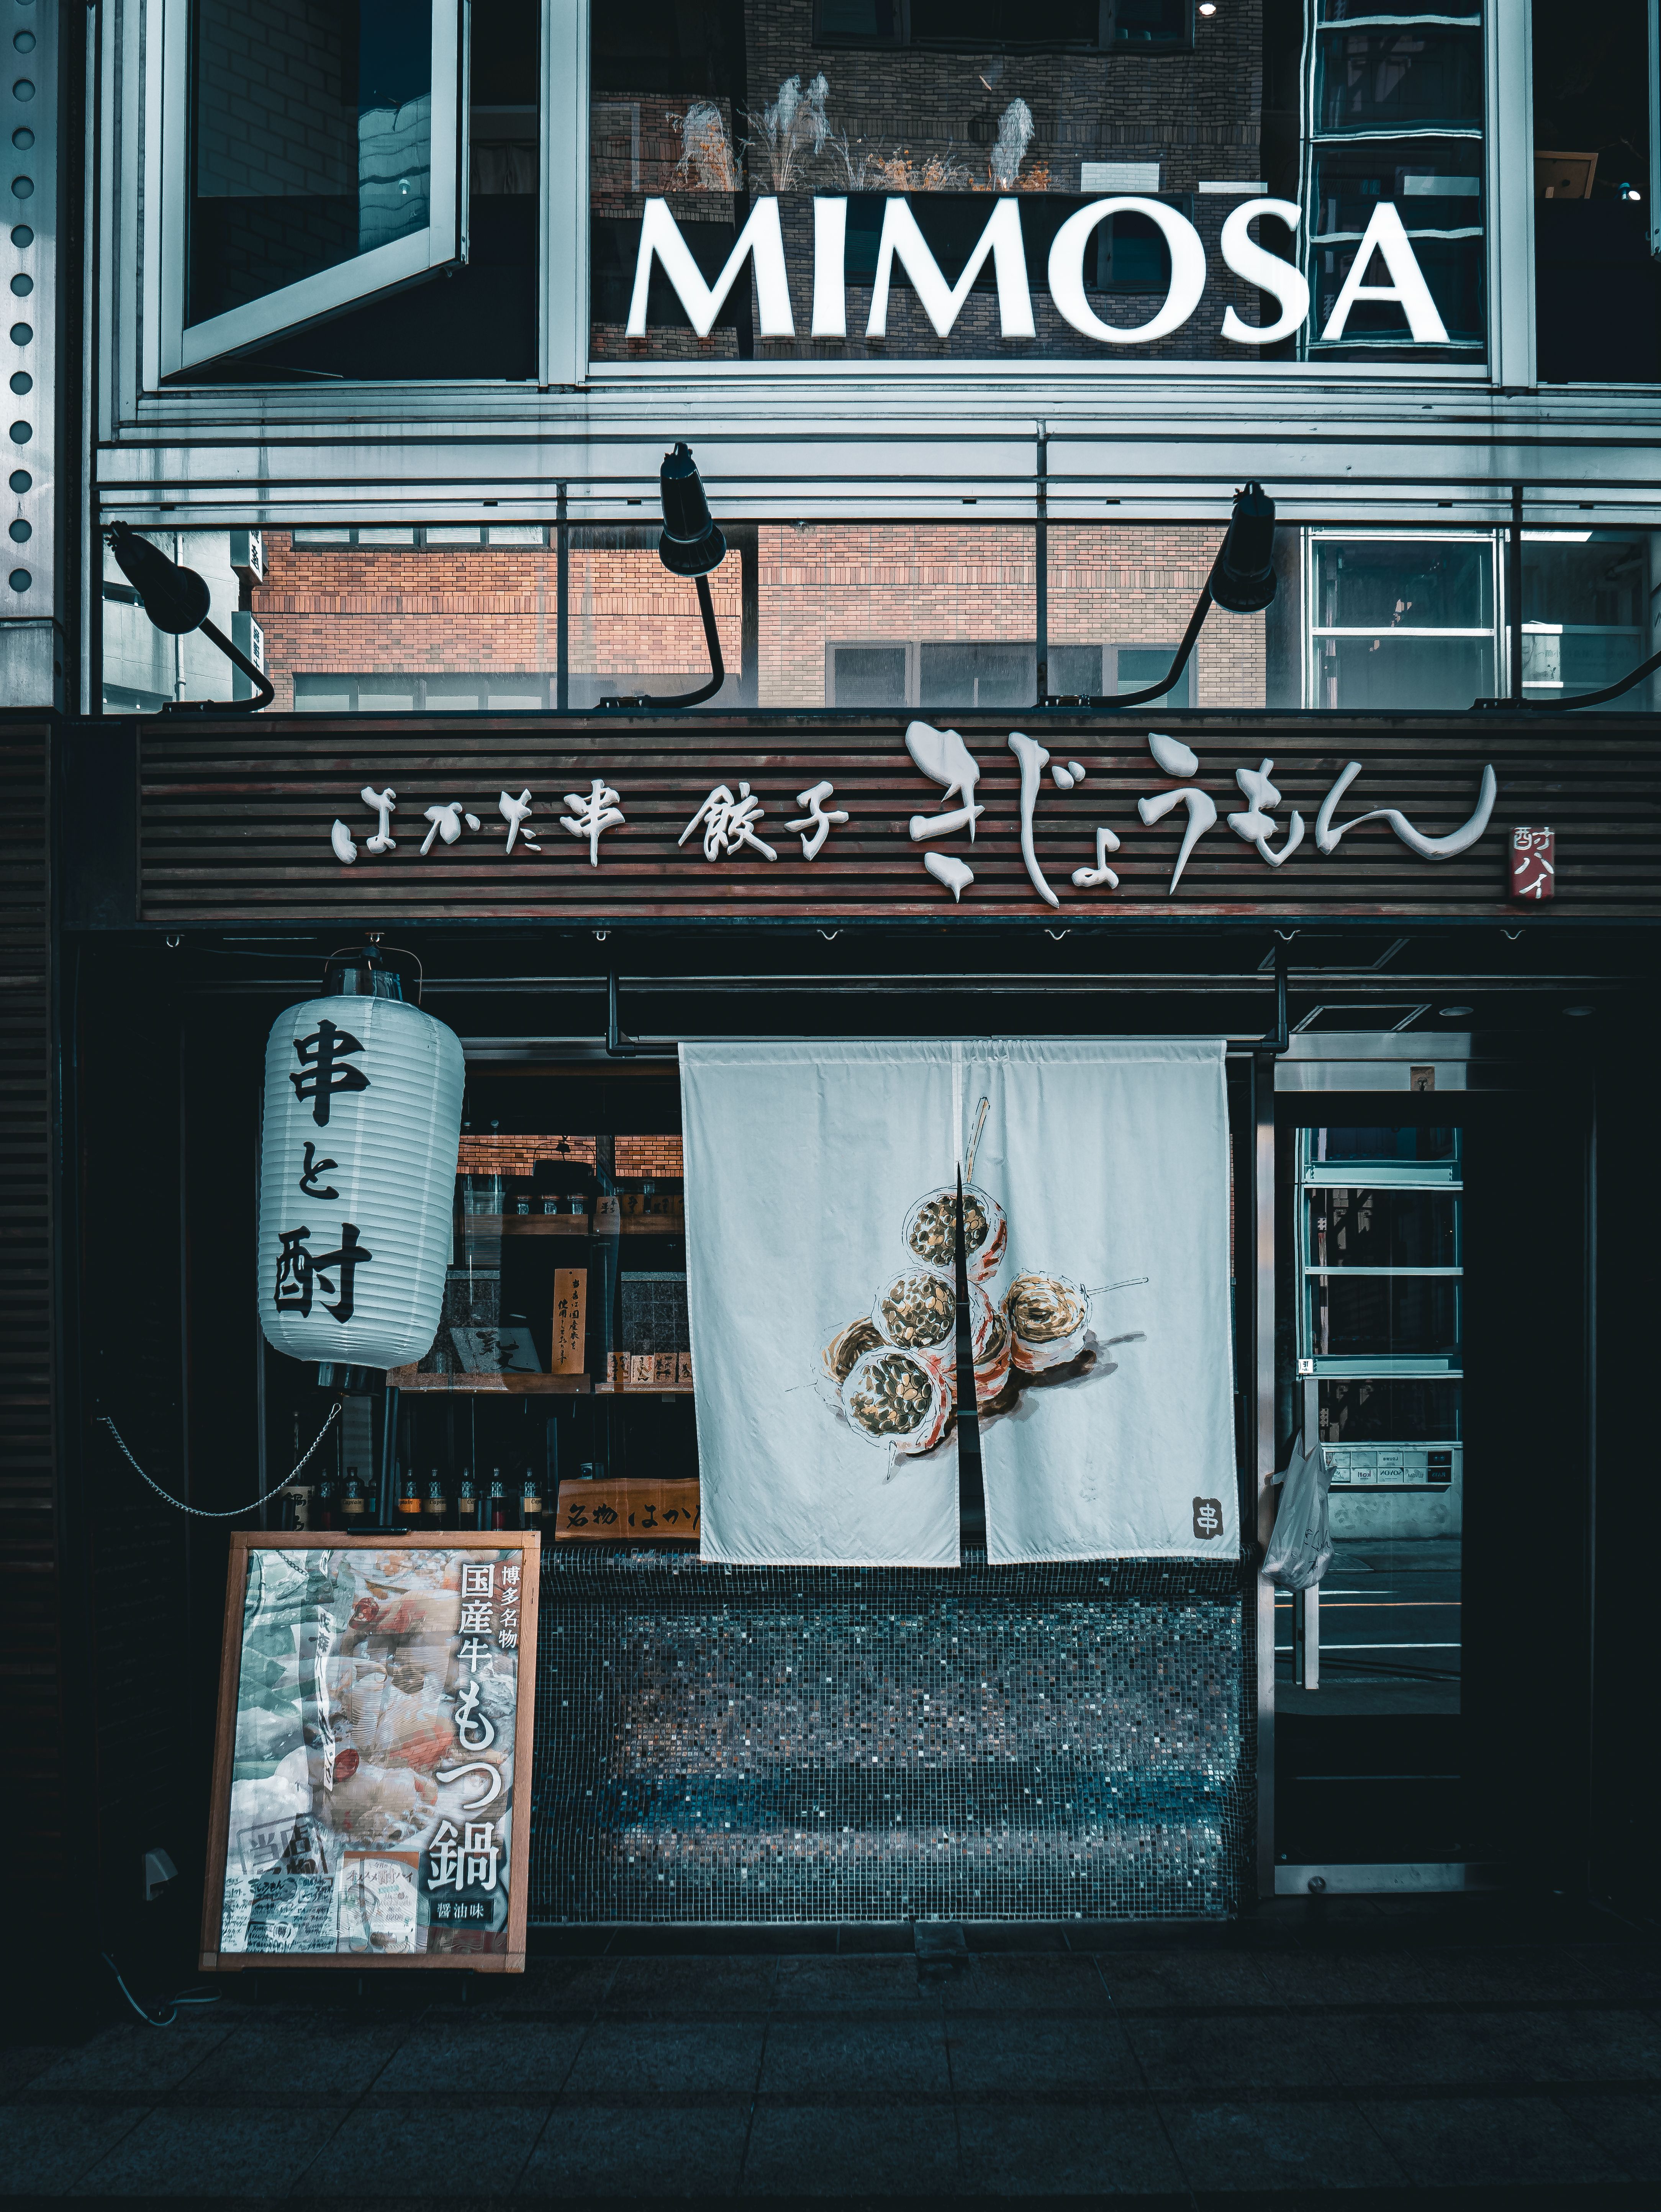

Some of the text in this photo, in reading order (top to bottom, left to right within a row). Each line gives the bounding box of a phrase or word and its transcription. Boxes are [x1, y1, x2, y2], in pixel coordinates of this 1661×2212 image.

[624, 195, 1450, 344] MIMOSA
[678, 781, 849, 862] 餃子
[905, 722, 1497, 908] きじょうもん
[1514, 827, 1555, 898] 酎ハイ
[274, 1019, 373, 1324] 串と酎
[1197, 1503, 1219, 1535] 串
[498, 1565, 521, 1649] 博多名物
[427, 1563, 502, 1891] 国産牛もつ鍋
